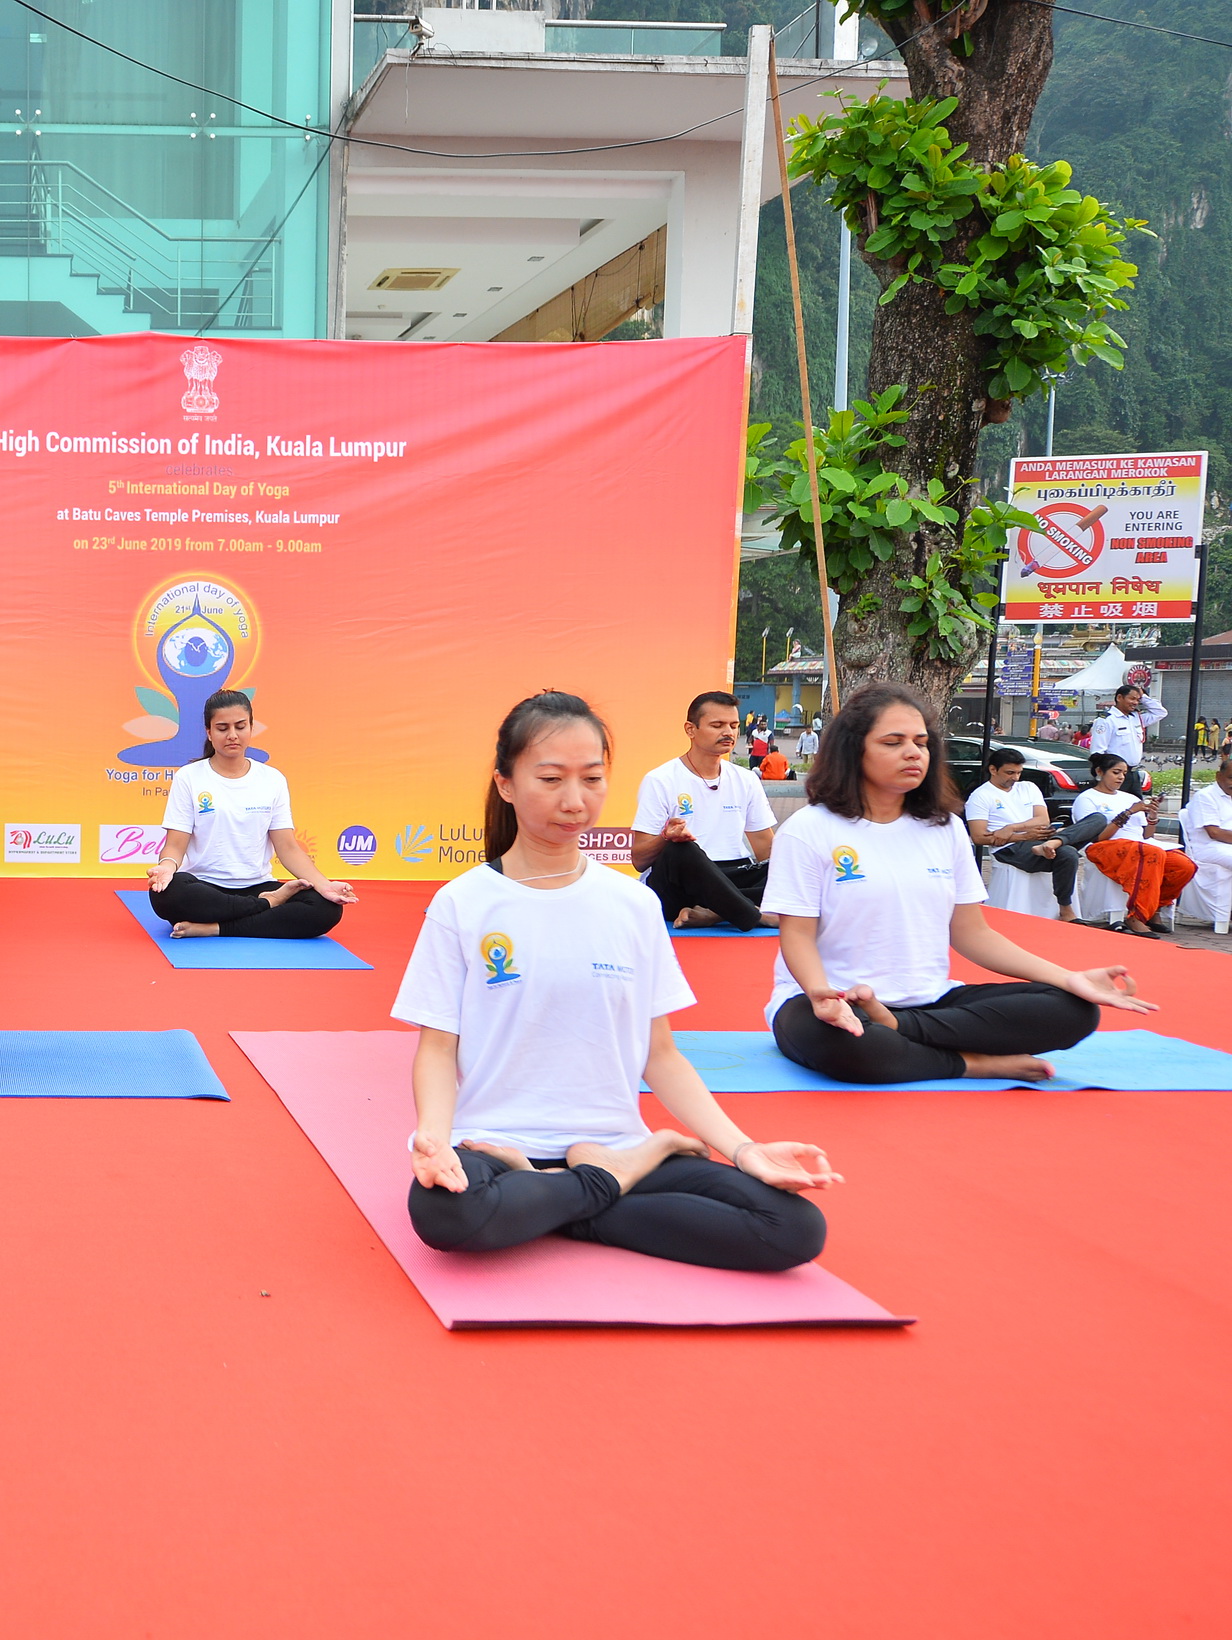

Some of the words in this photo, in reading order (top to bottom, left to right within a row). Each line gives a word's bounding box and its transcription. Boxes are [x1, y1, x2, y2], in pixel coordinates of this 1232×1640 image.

[45, 431, 172, 456] Commission
[177, 433, 198, 456] of
[204, 433, 260, 458] India,
[266, 434, 324, 456] Kuala
[329, 437, 406, 462] Lumpur
[166, 463, 233, 477] celebrates
[1020, 462, 1053, 472] ANDA
[1056, 460, 1116, 470] MEMASUKI
[1120, 459, 1134, 468] KE
[1138, 458, 1196, 468] KAWASAN
[1045, 470, 1108, 480] LARANGAN
[1110, 468, 1168, 478] MEROKOK
[108, 479, 124, 494] 5th
[127, 480, 208, 496] International
[214, 481, 237, 498] Day
[241, 482, 255, 497] of
[257, 482, 290, 499] Yoga
[56, 509, 69, 521] at
[72, 507, 101, 521] Batu
[104, 508, 141, 522] Caves
[144, 508, 189, 525] Temple
[192, 509, 252, 525] Premises,
[256, 510, 290, 524] Kuala
[293, 511, 340, 527] Lumpur
[1130, 511, 1153, 520] YOU
[1156, 510, 1179, 519] ARE
[1125, 522, 1183, 532] ENTERING
[73, 539, 88, 550] on
[91, 536, 116, 551] 23rd
[117, 537, 147, 551] June
[150, 537, 182, 551] 2019
[185, 538, 213, 551] from
[217, 539, 263, 552] 7.00am
[276, 540, 322, 552] 9.00am
[1034, 513, 1049, 530] NO
[1046, 526, 1094, 565] SMOKING
[1110, 538, 1135, 550] NON
[1137, 536, 1193, 549] SMOKING
[1135, 552, 1168, 564] AREA
[1111, 576, 1162, 595] निषेध
[145, 582, 200, 637] International
[203, 582, 226, 600] day
[226, 596, 240, 608] of
[233, 608, 248, 638] yoga
[175, 605, 191, 614] 21st
[202, 606, 223, 614] June
[1039, 602, 1158, 618] 禁止吸烟
[106, 769, 138, 783] Yoga
[142, 768, 160, 781] for
[142, 787, 152, 796] In
[440, 824, 483, 841] LuLu
[339, 835, 374, 851] IJM
[592, 963, 615, 971] TATA
